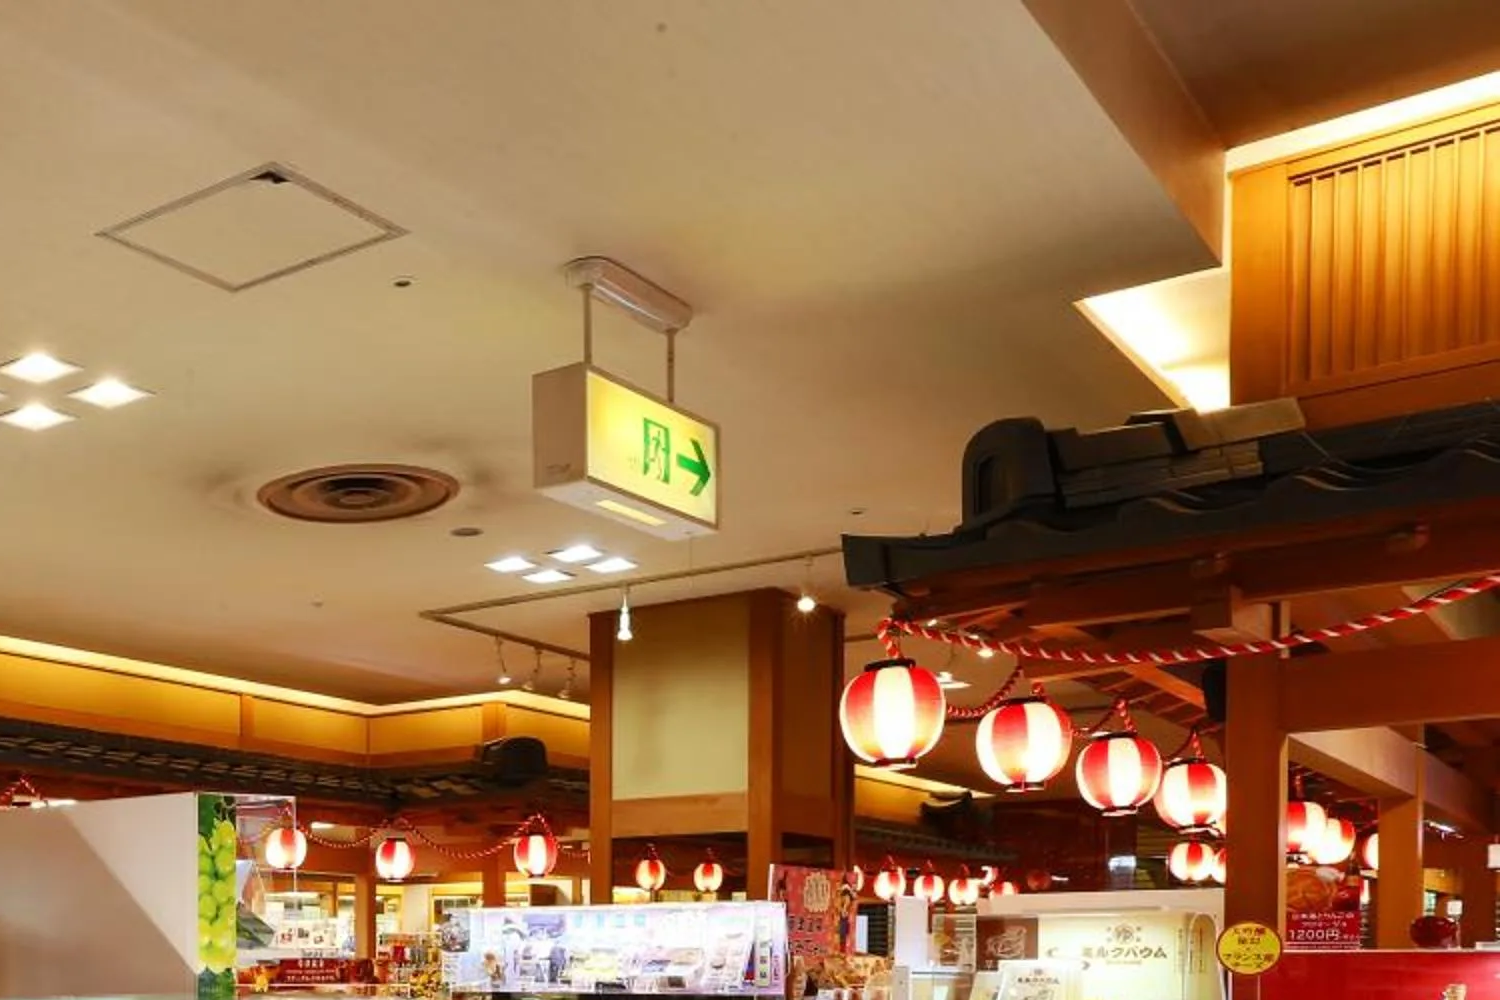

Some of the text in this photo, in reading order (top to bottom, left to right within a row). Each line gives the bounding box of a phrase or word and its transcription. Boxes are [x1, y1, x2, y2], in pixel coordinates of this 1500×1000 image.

[1082, 945, 1168, 960] ミルクバウム
